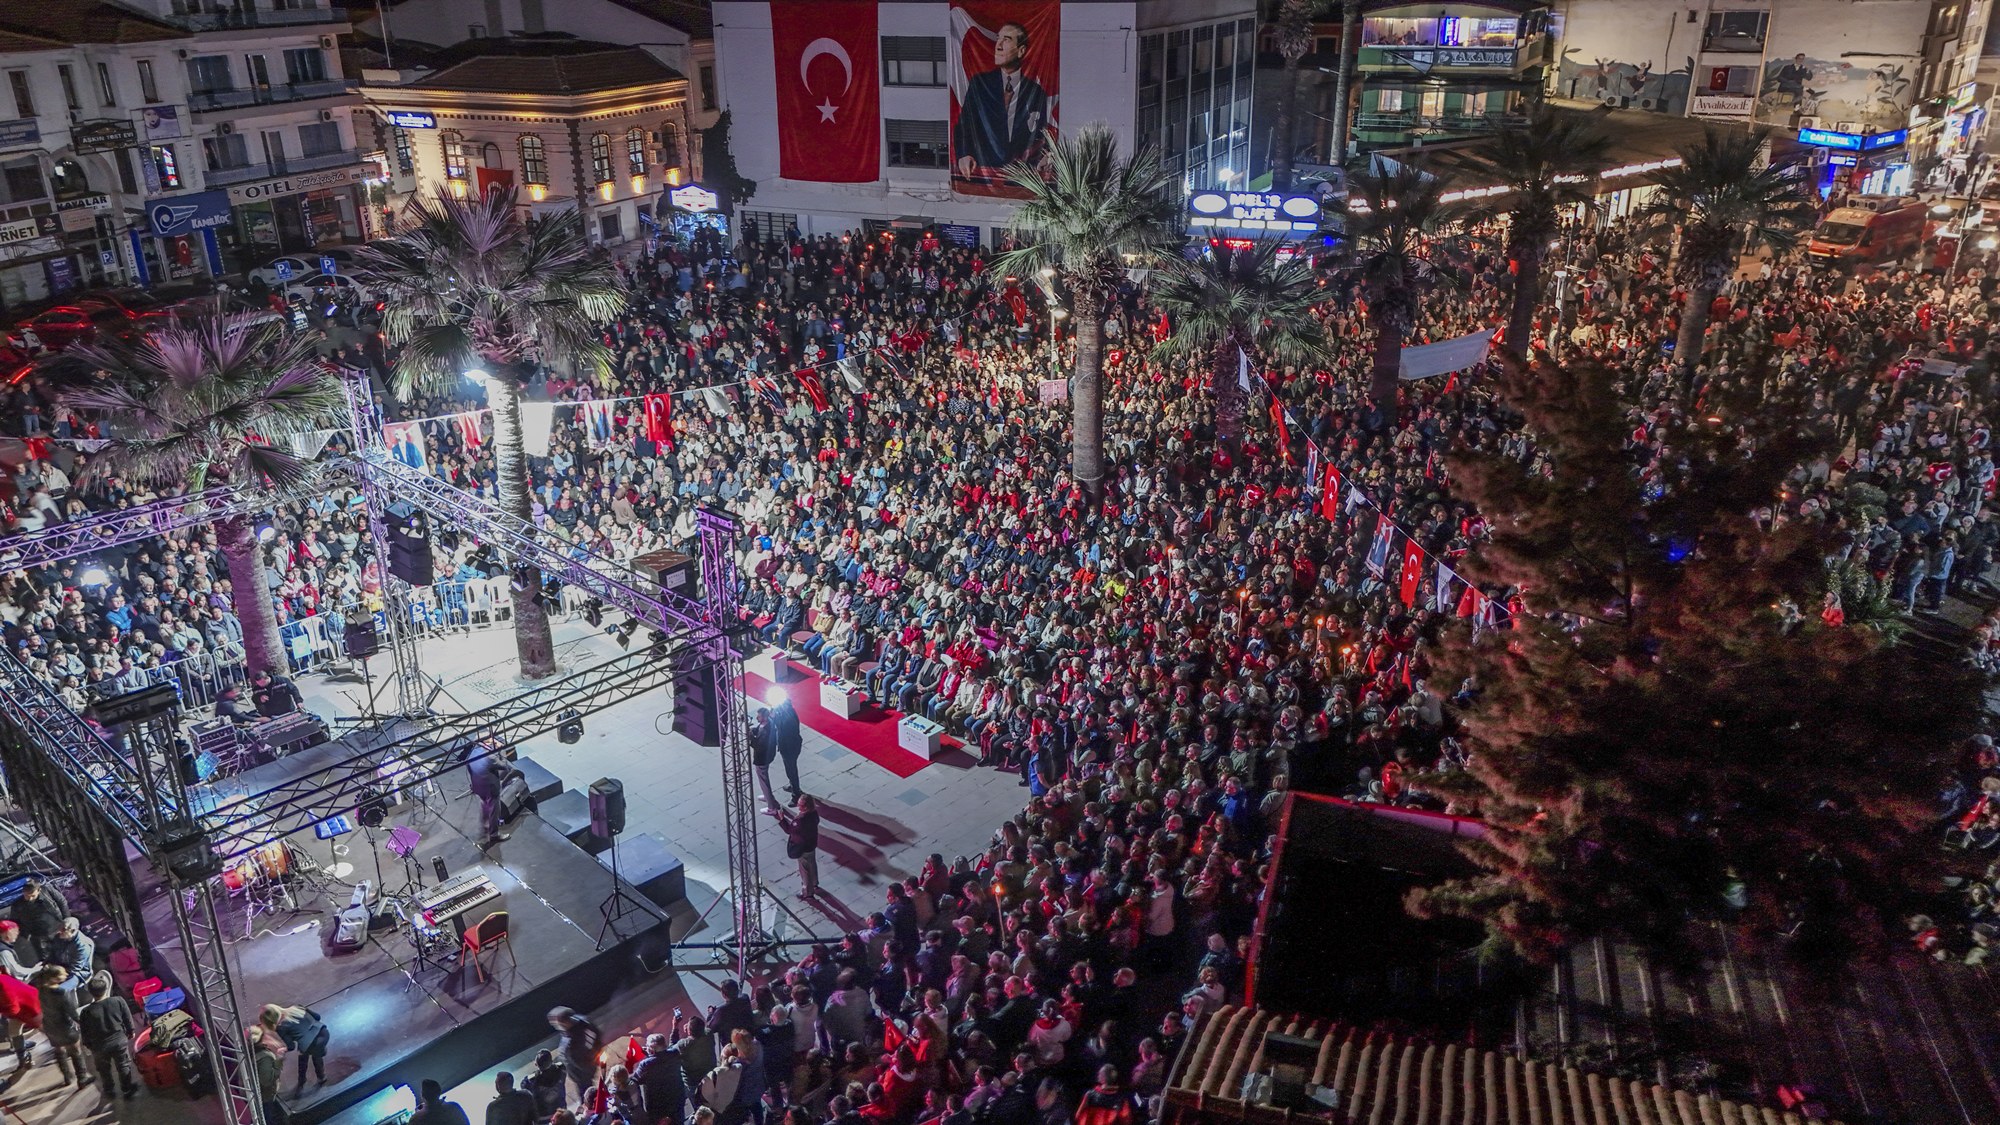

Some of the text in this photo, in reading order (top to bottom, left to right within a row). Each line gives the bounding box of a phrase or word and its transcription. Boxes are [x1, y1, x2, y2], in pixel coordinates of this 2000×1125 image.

[1450, 51, 1512, 63] YAKAMOZ
[245, 181, 295, 199] OTEL
[277, 264, 285, 275] P
[323, 260, 332, 269] P
